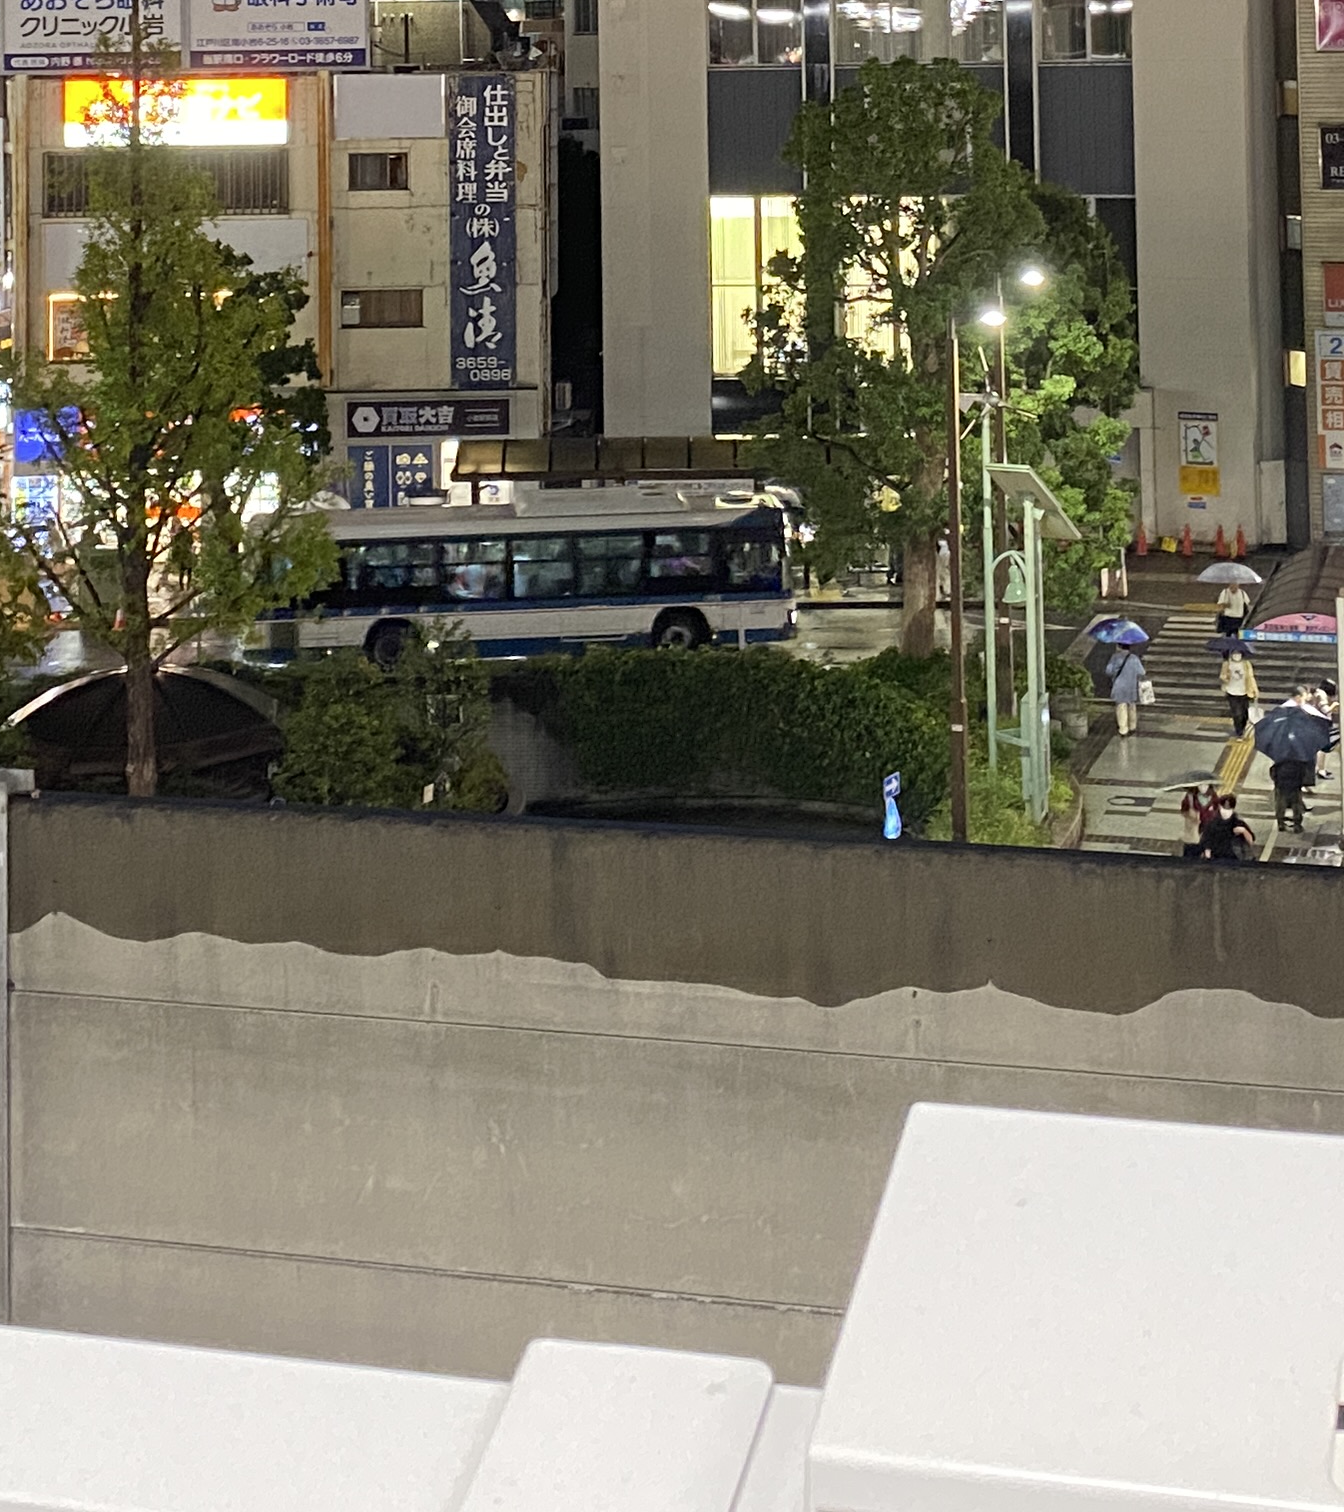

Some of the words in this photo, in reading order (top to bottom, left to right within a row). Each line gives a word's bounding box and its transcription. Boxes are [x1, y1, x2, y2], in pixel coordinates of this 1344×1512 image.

[20, 14, 164, 37] クリニック小岩
[456, 95, 477, 203] 御会席料理
[483, 85, 512, 203] 仕出しと弁当
[381, 406, 455, 424] 買取大吉
